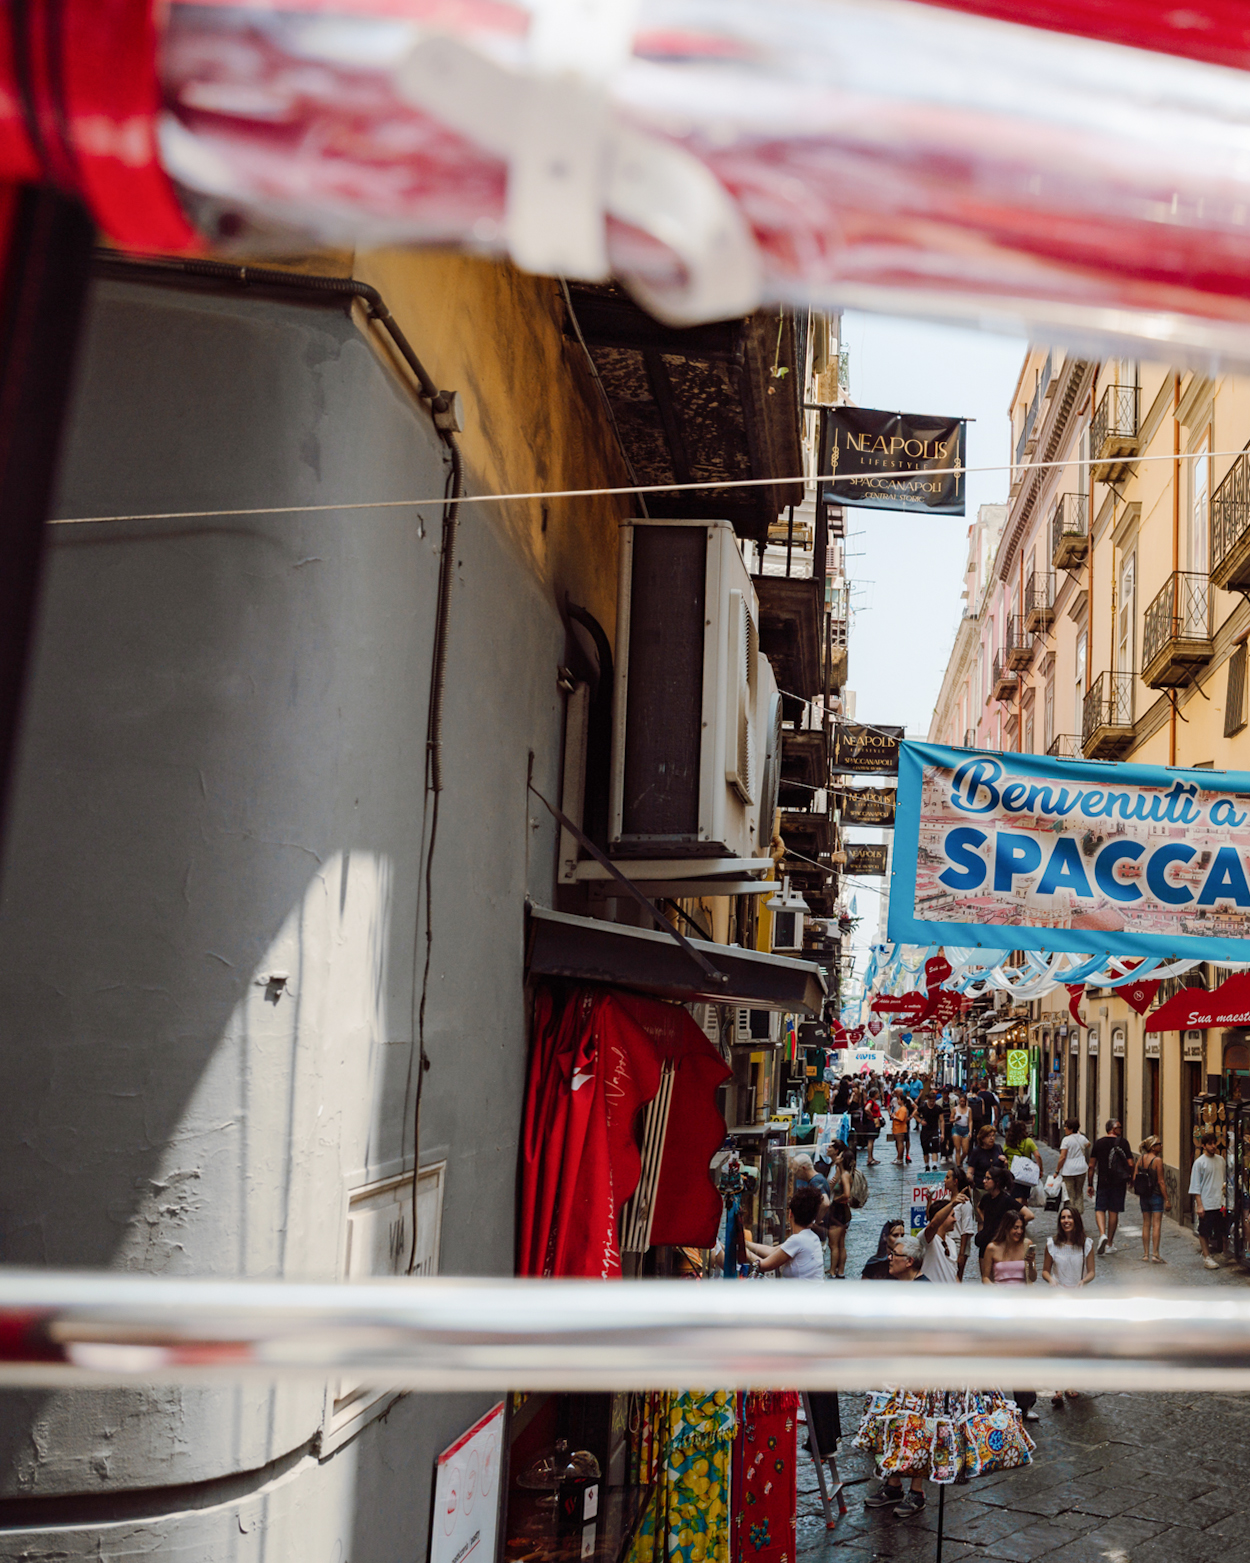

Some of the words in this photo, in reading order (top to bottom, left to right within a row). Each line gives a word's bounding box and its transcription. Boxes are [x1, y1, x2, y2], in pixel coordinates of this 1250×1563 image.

[846, 431, 948, 459] NEAPOLIS
[860, 457, 929, 471] LIFESTYLE
[850, 477, 942, 493] SPACCANAPOLI
[843, 734, 896, 748] NEAPOLIS
[950, 758, 1202, 825] Benvenuti
[1209, 799, 1248, 827] a
[1186, 1011, 1212, 1025] Sua
[913, 1187, 951, 1202] PROM
